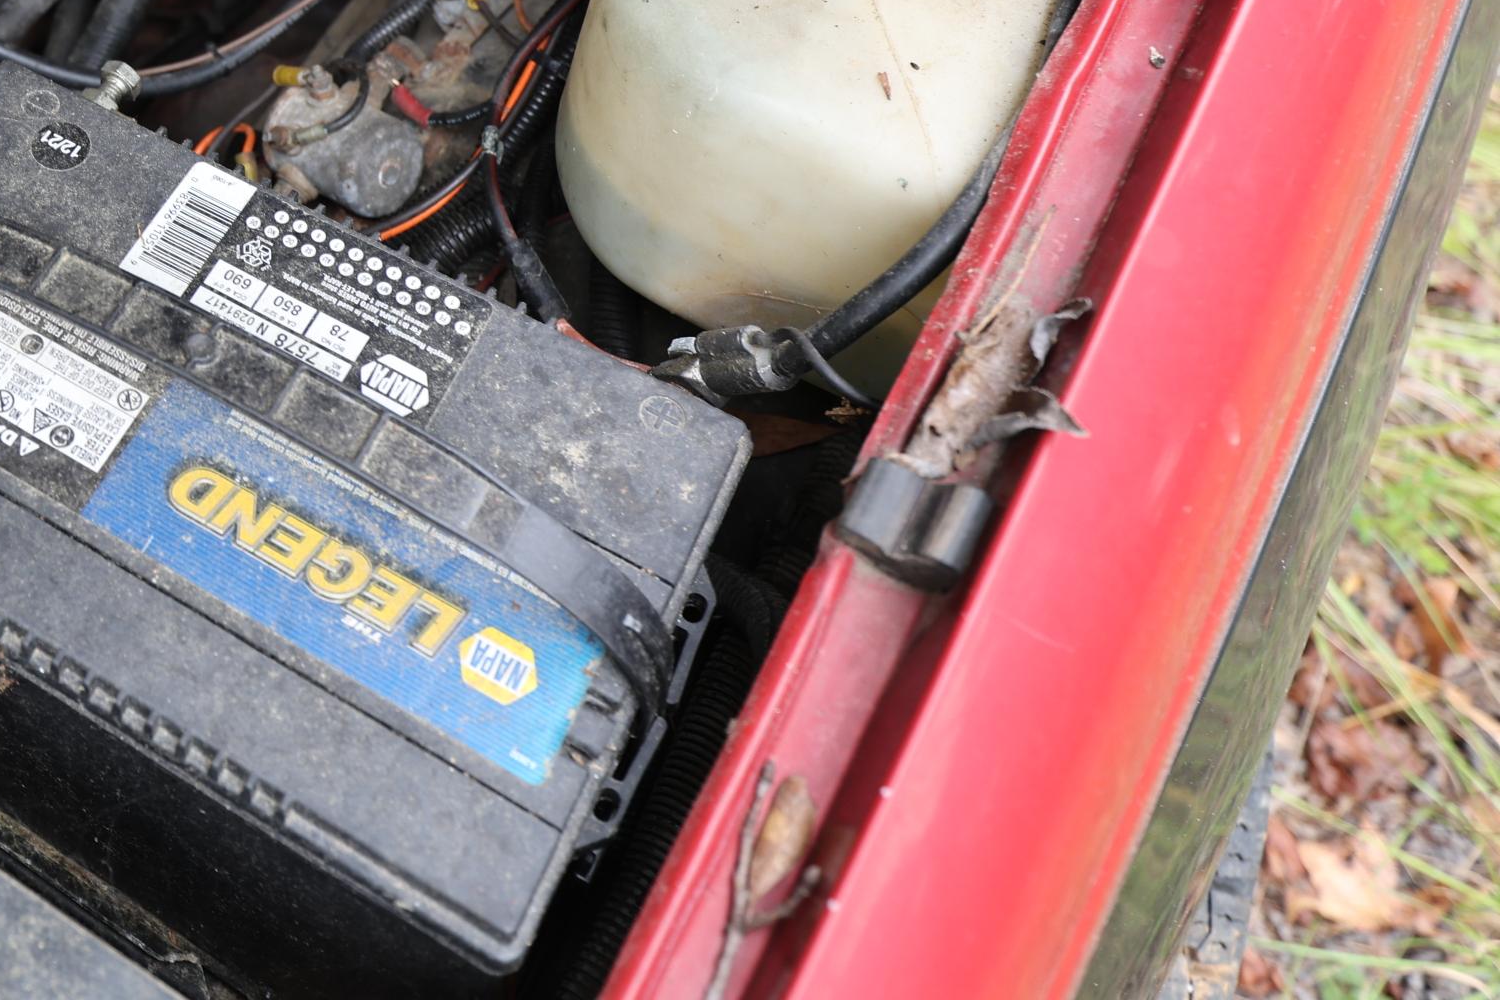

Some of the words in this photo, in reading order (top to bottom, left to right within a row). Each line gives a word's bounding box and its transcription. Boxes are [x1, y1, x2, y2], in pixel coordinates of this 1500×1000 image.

[40, 130, 82, 157] 12/21
[162, 191, 188, 221] 83996
[141, 222, 165, 251] 11051
[221, 267, 254, 291] 690
[270, 293, 303, 317] 850
[335, 288, 361, 304] PARTS
[358, 299, 380, 314] AUTO
[203, 294, 256, 326] 0291417
[377, 309, 399, 323] NAPA
[60, 331, 76, 344] OF
[254, 321, 270, 336] N
[326, 322, 352, 342] 78
[72, 338, 99, 357] RISK
[271, 331, 322, 365] 7578
[424, 344, 454, 363] Recycle
[51, 361, 69, 375] THE
[92, 350, 142, 381] WARNING:
[77, 376, 95, 389] OUT
[93, 384, 114, 399] KEEP
[95, 373, 120, 391] REACH
[362, 362, 424, 406] NAPA
[44, 388, 84, 414] BLINDNESS
[44, 401, 73, 422] GASES
[7, 407, 23, 421] NO
[81, 408, 106, 427] CAUSE
[68, 415, 114, 445] EXPLOSIVE
[103, 421, 120, 435] CAN
[69, 443, 100, 466] SHIELD
[166, 463, 468, 659] LEGEND
[338, 611, 384, 645] THE
[471, 637, 529, 693] NAPA
